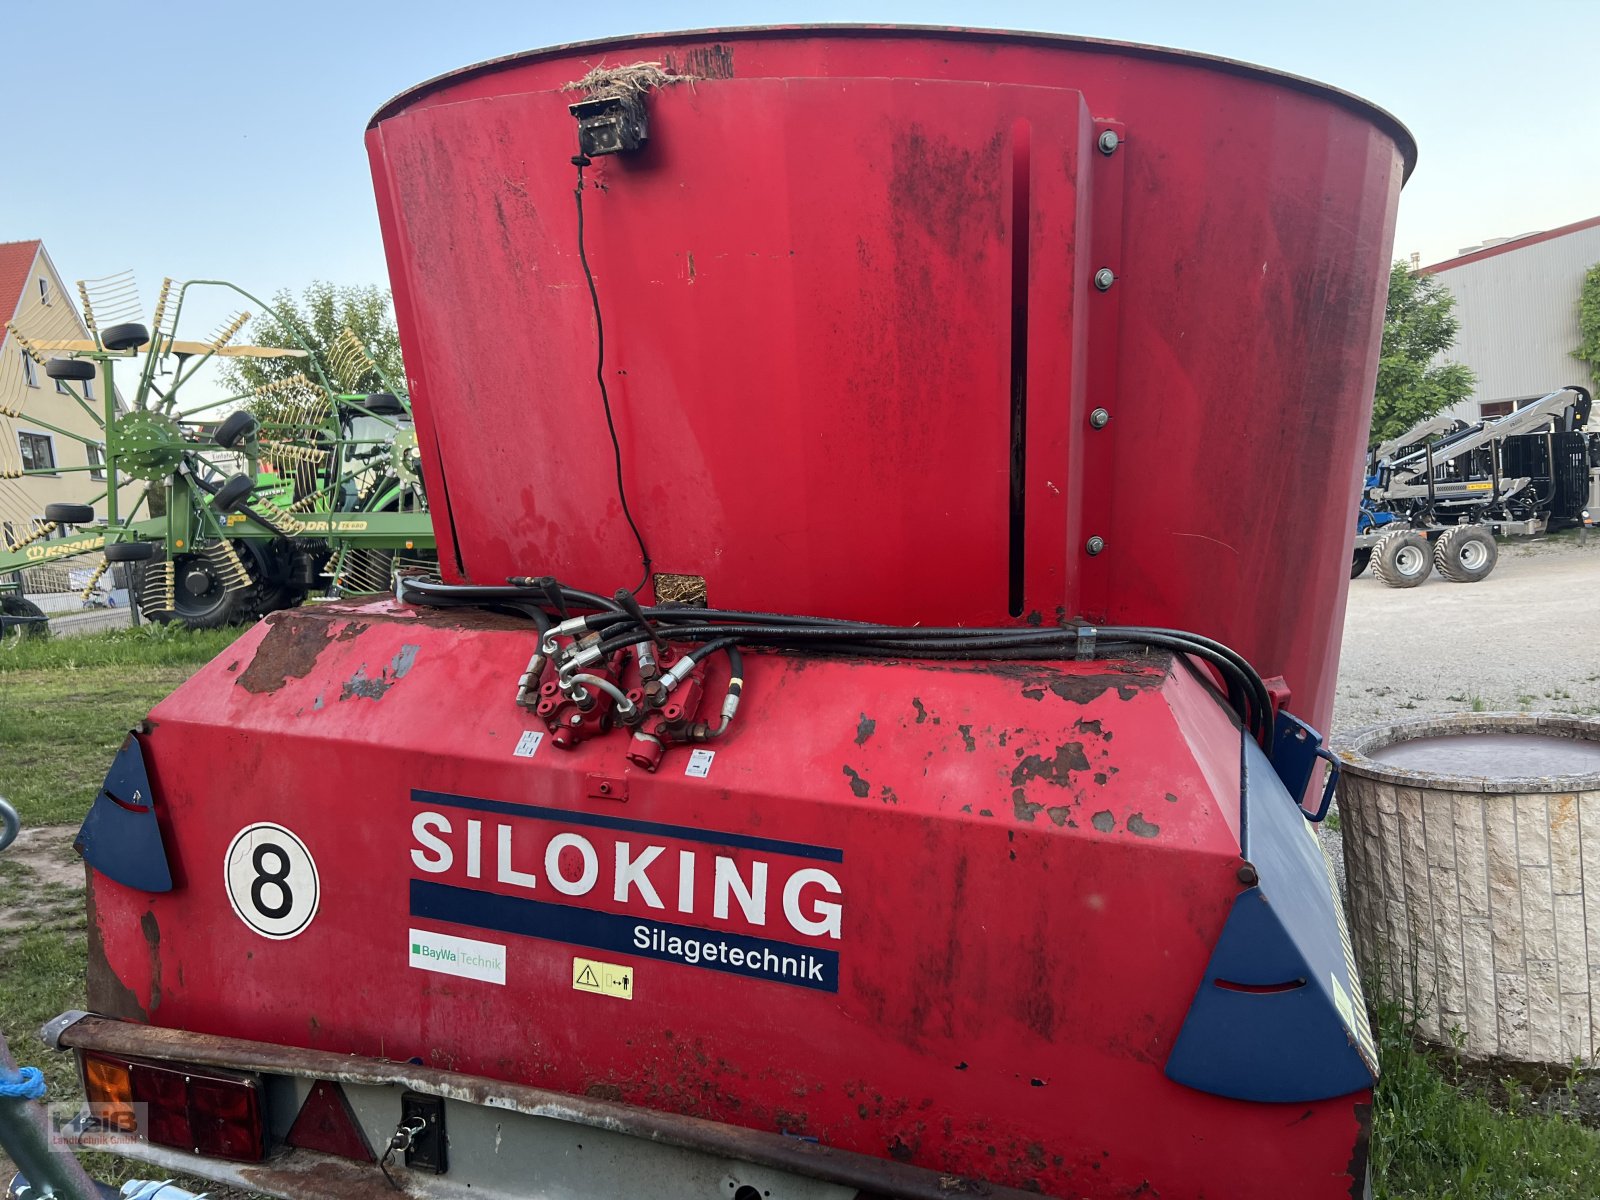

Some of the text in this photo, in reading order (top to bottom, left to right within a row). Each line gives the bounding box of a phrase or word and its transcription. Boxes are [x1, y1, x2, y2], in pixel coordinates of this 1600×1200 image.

[45, 536, 106, 557] KRONE
[251, 842, 294, 920] 8
[410, 811, 843, 940] SILOKING
[422, 945, 501, 970] BayWa Technik
[633, 925, 824, 983] Silagetechnik
